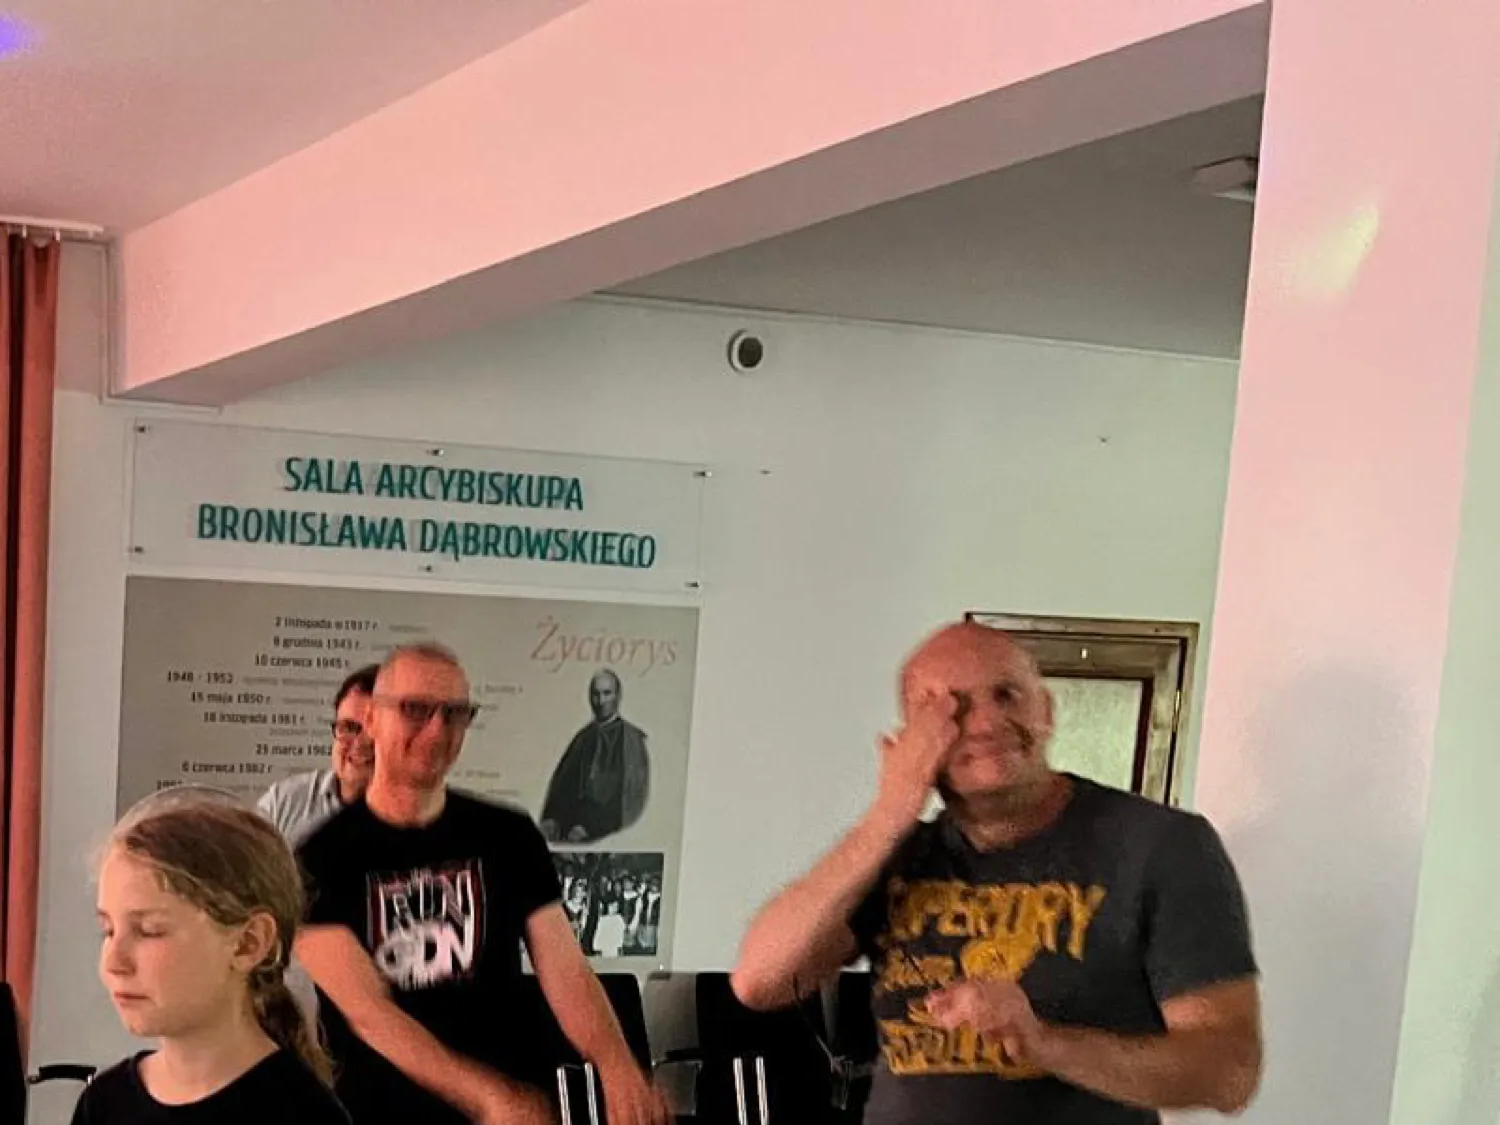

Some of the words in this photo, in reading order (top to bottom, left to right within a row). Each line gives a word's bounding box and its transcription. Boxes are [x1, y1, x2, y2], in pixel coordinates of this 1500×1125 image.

[283, 456, 364, 496] SALA
[375, 462, 584, 511] ARCYBISKUPA
[197, 503, 407, 552] BRONISŁAWA
[419, 518, 656, 569] DĄBROWSKIEGO
[531, 614, 679, 678] Życiorys
